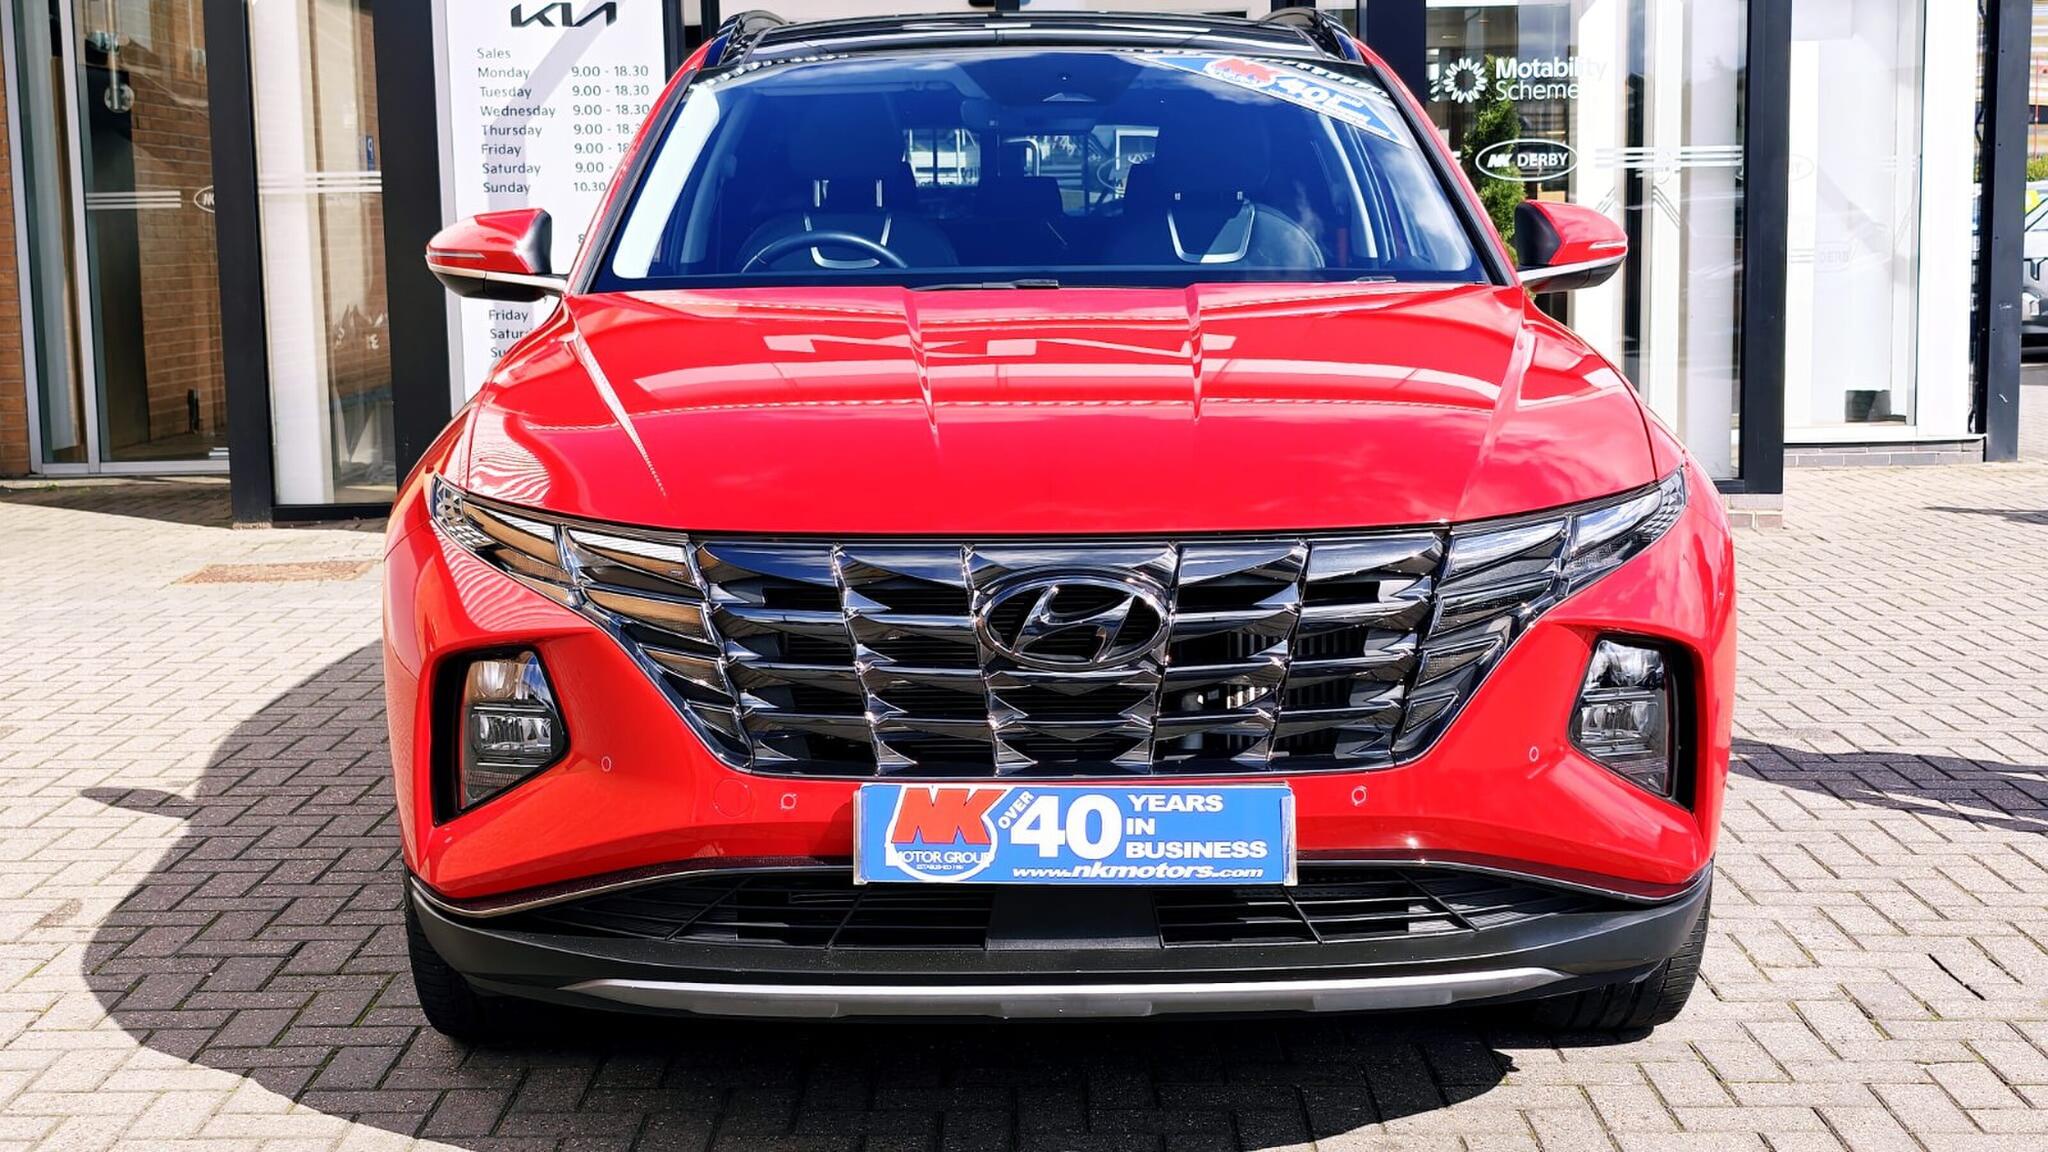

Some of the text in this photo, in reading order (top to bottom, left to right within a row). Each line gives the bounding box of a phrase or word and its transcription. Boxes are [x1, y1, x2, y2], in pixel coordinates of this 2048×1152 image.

[477, 48, 511, 59] Sales
[477, 67, 530, 81] Monday
[571, 65, 601, 77] 9.00
[614, 65, 649, 77] 18.30
[480, 86, 532, 100] Tuesday
[572, 85, 602, 97] 9.00
[615, 84, 650, 96] 18.30
[1495, 80, 1579, 100] Scheme
[480, 106, 556, 119] Wednesday
[572, 104, 603, 116] 9.00
[616, 104, 650, 115] 18.30
[482, 125, 542, 138] Thursday
[573, 123, 603, 135] 9.00
[481, 143, 522, 156] Friday
[574, 142, 604, 154] 9.00
[1517, 153, 1568, 167] DERBY
[482, 163, 541, 176] Saturday
[575, 162, 604, 174] 9.00
[483, 181, 606, 195] Sunday 10.30
[489, 309, 528, 323] Friday
[1127, 794, 1224, 812] YEARS
[891, 787, 1007, 844] NK
[998, 791, 1123, 860] OVER 40
[1126, 818, 1156, 835] IN
[1126, 841, 1268, 859] BUSINESS
[1013, 861, 1264, 879] www.nkmotors.com
